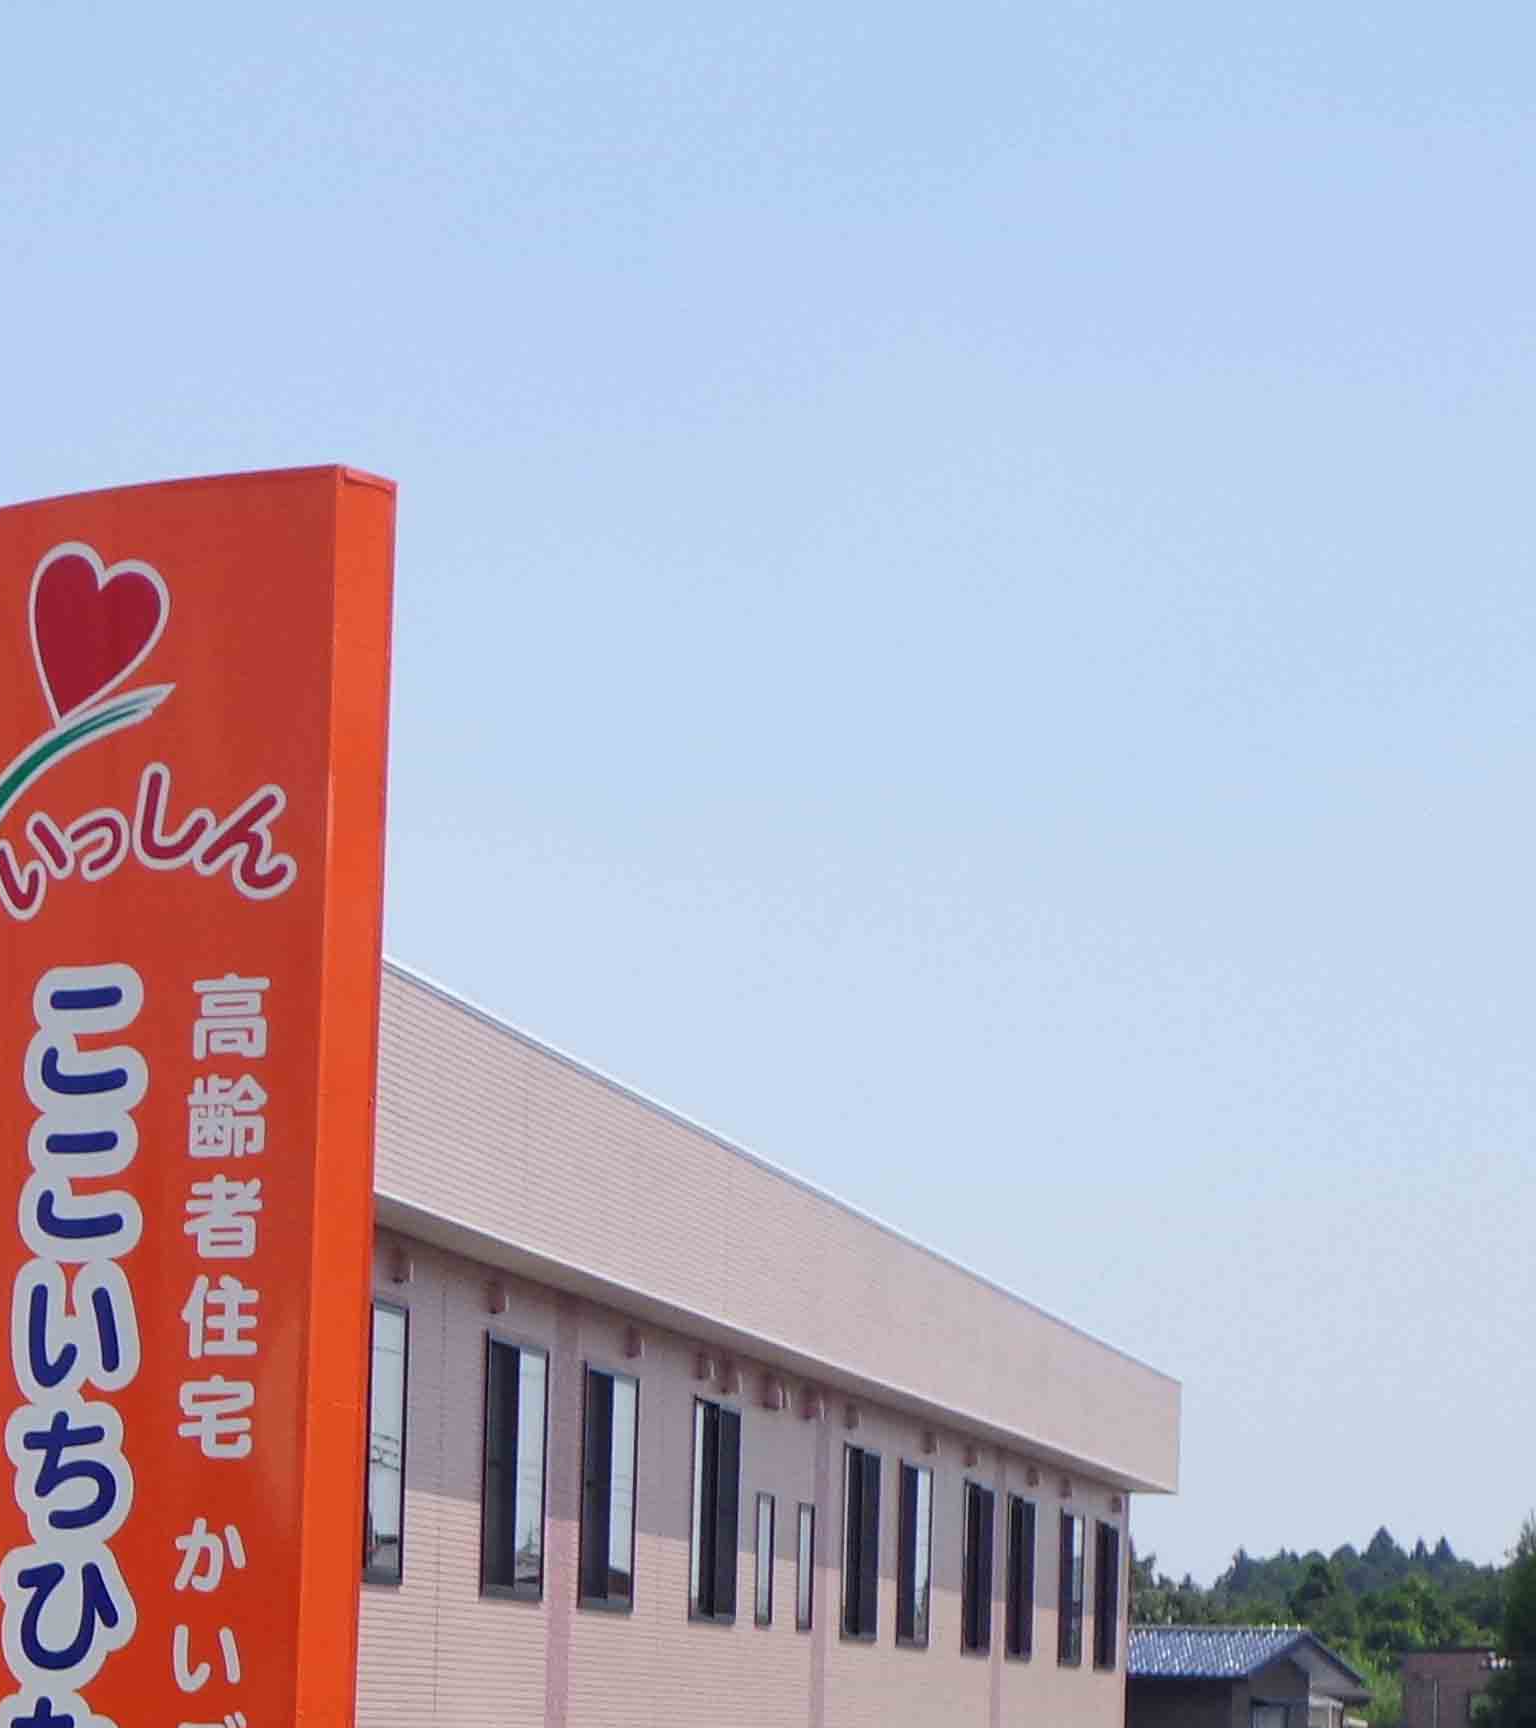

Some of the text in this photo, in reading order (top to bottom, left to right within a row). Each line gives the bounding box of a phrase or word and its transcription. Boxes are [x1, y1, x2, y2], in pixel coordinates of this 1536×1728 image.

[178, 971, 271, 1459] 高齢者住宅
